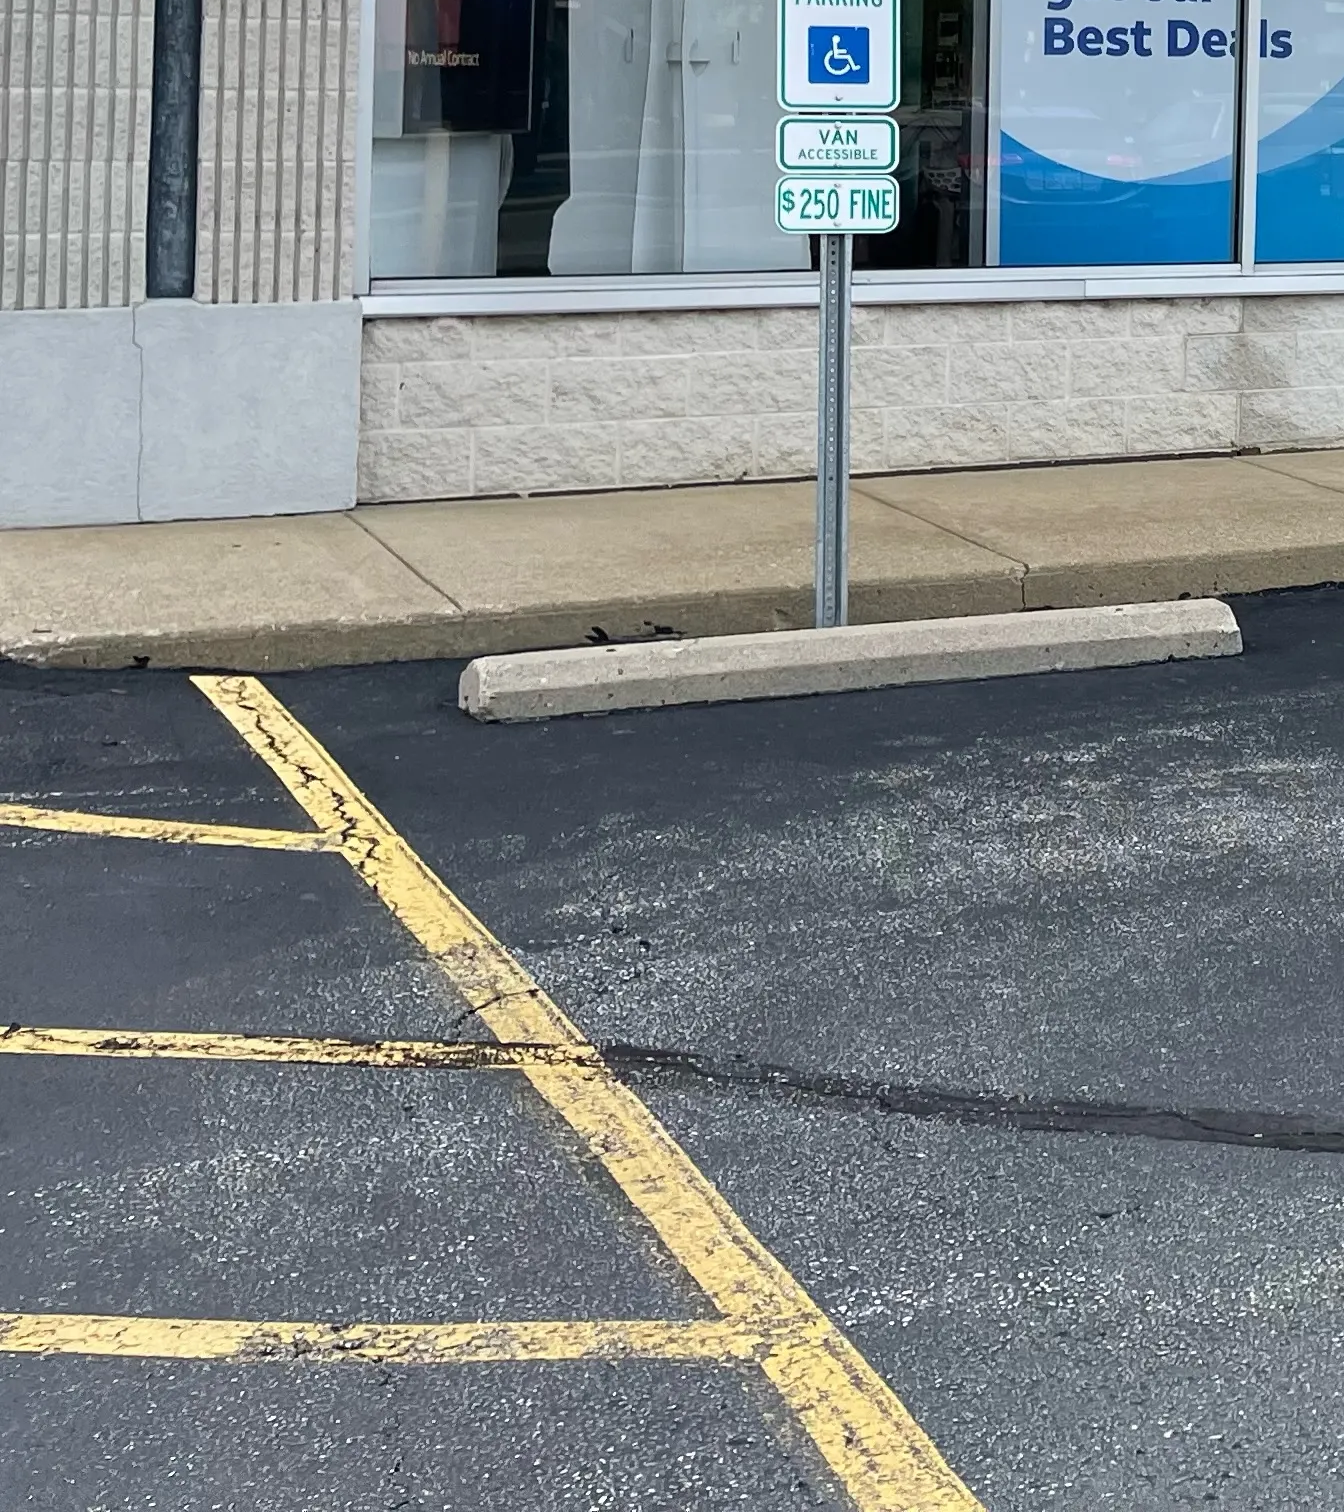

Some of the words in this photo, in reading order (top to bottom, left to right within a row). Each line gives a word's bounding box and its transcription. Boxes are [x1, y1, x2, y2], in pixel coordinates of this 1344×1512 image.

[1044, 17, 1152, 57] Best
[819, 129, 858, 145] VAN
[798, 148, 878, 160] ACCESSIBLE
[850, 189, 892, 220] FINE
